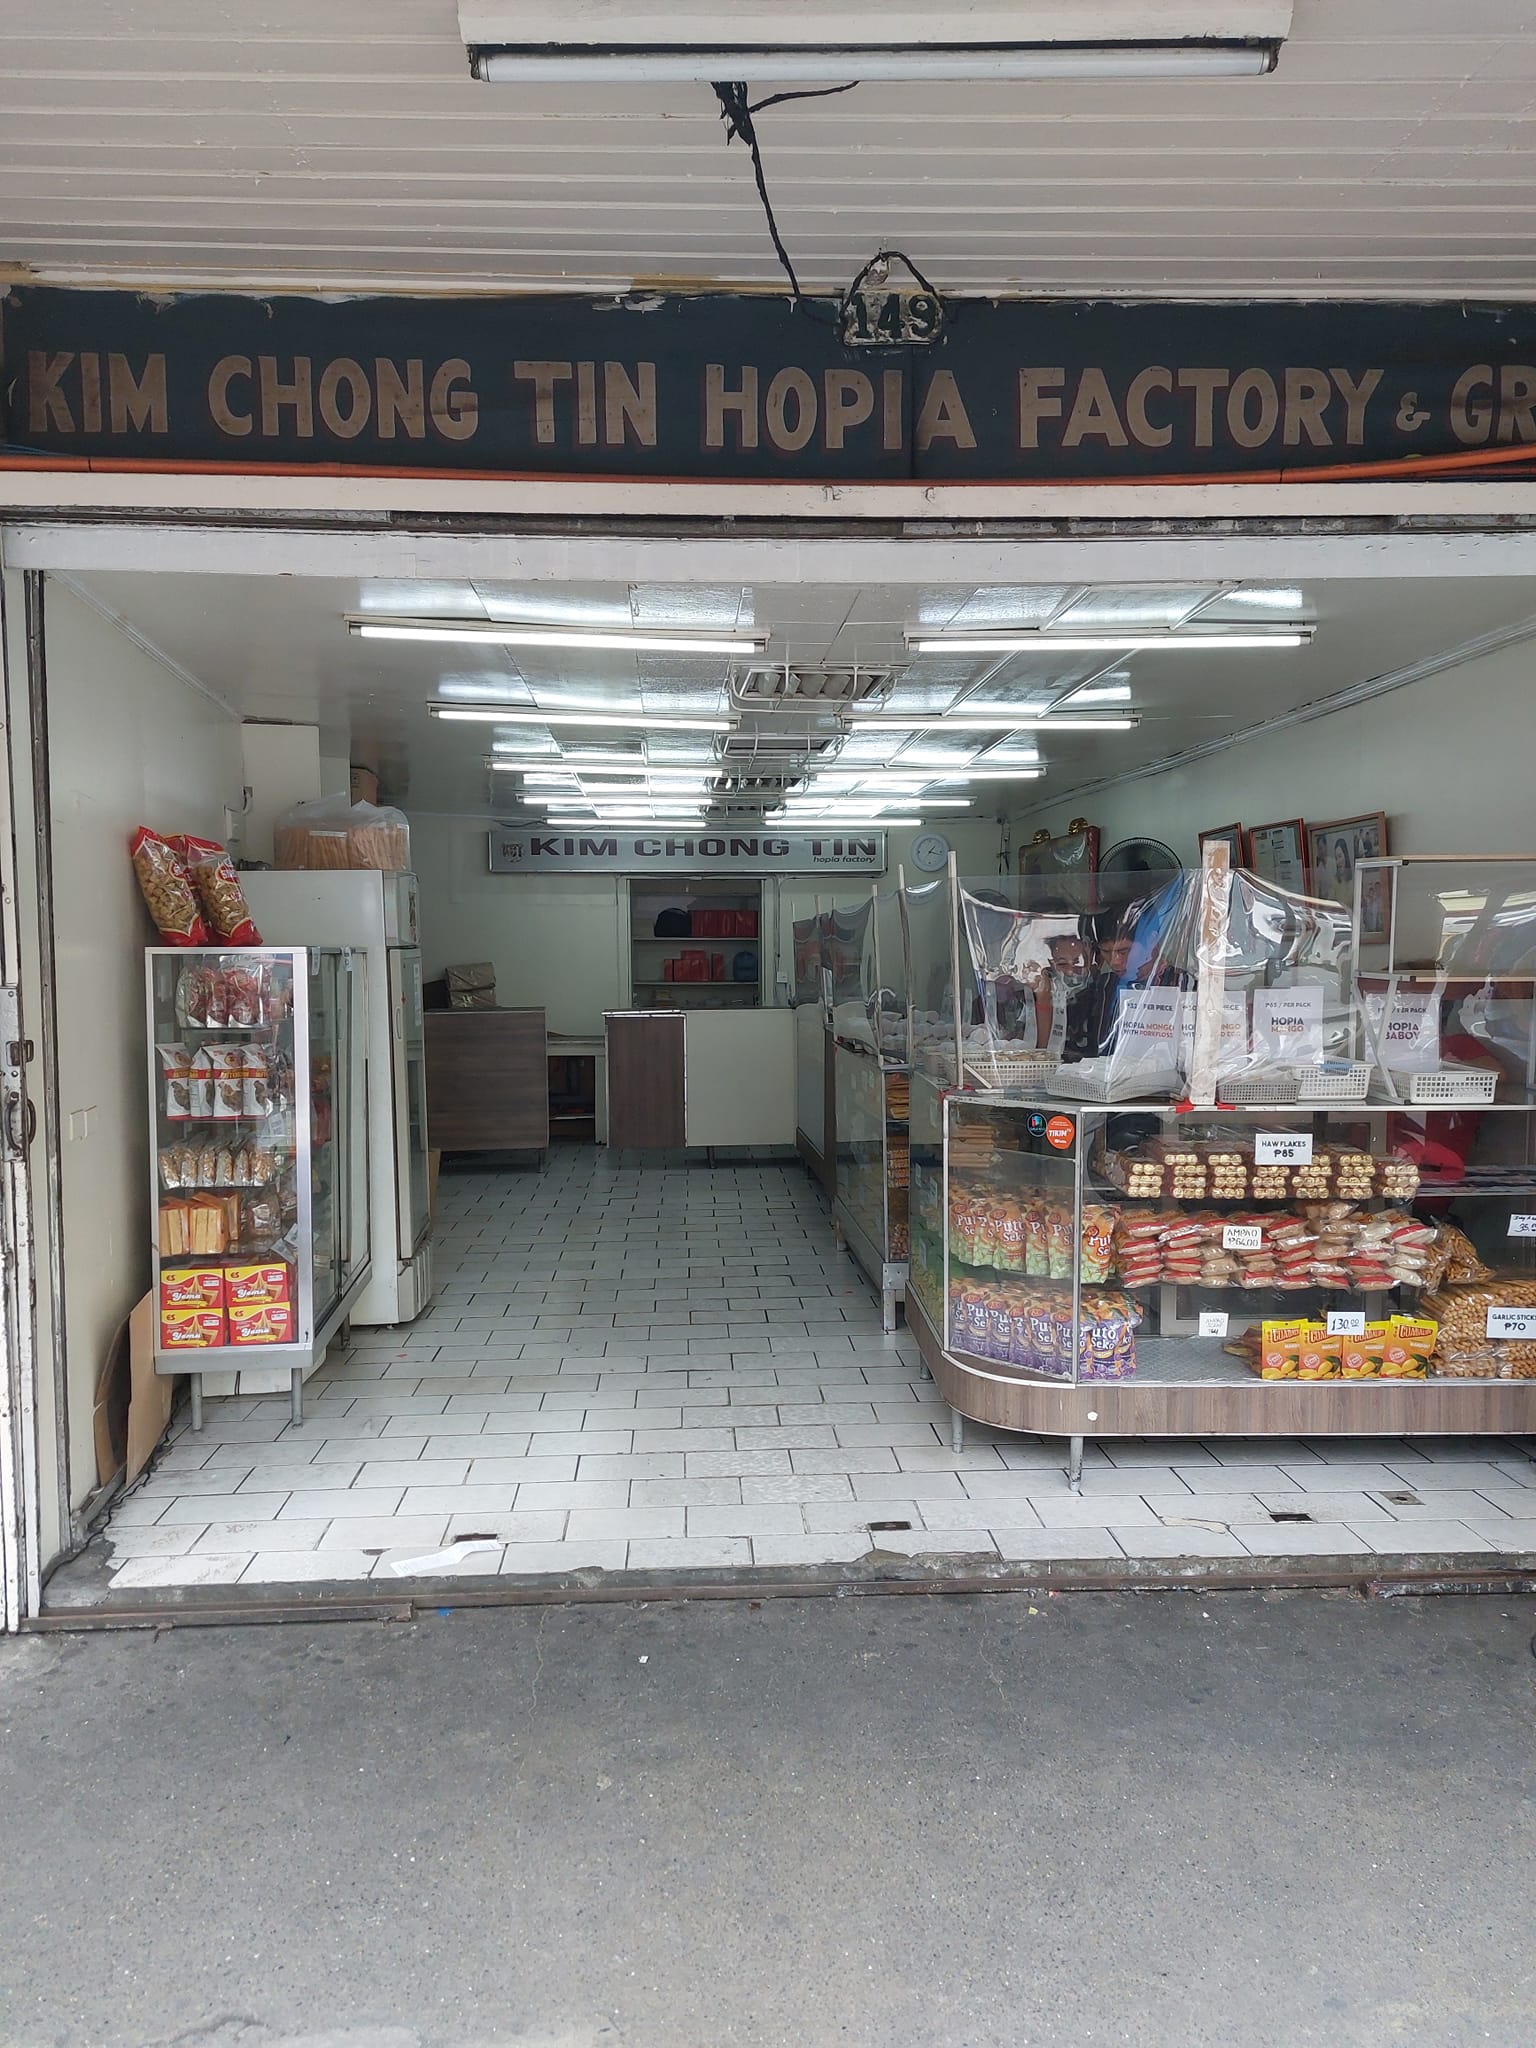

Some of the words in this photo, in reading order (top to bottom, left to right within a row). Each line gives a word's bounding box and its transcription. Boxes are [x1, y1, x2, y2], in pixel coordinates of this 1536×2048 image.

[851, 291, 937, 339] 149
[28, 351, 169, 434] KIM
[208, 356, 479, 441] CHONG
[514, 361, 657, 446] TIN
[706, 363, 978, 451] HOPIA
[1018, 365, 1386, 449] FACTORY
[1395, 391, 1431, 432] &
[1450, 364, 1536, 444] GR
[530, 838, 617, 856] KIM
[634, 838, 790, 857] CHONG
[803, 838, 876, 856] TIN
[813, 856, 840, 864] hopia
[842, 856, 876, 864] factory
[1123, 1021, 1145, 1030] HOPIA
[1146, 1023, 1175, 1031] MONGO
[1271, 1017, 1304, 1026] HOPIA
[1227, 1229, 1258, 1237] AMPAO
[1091, 1337, 1115, 1350] Seko
